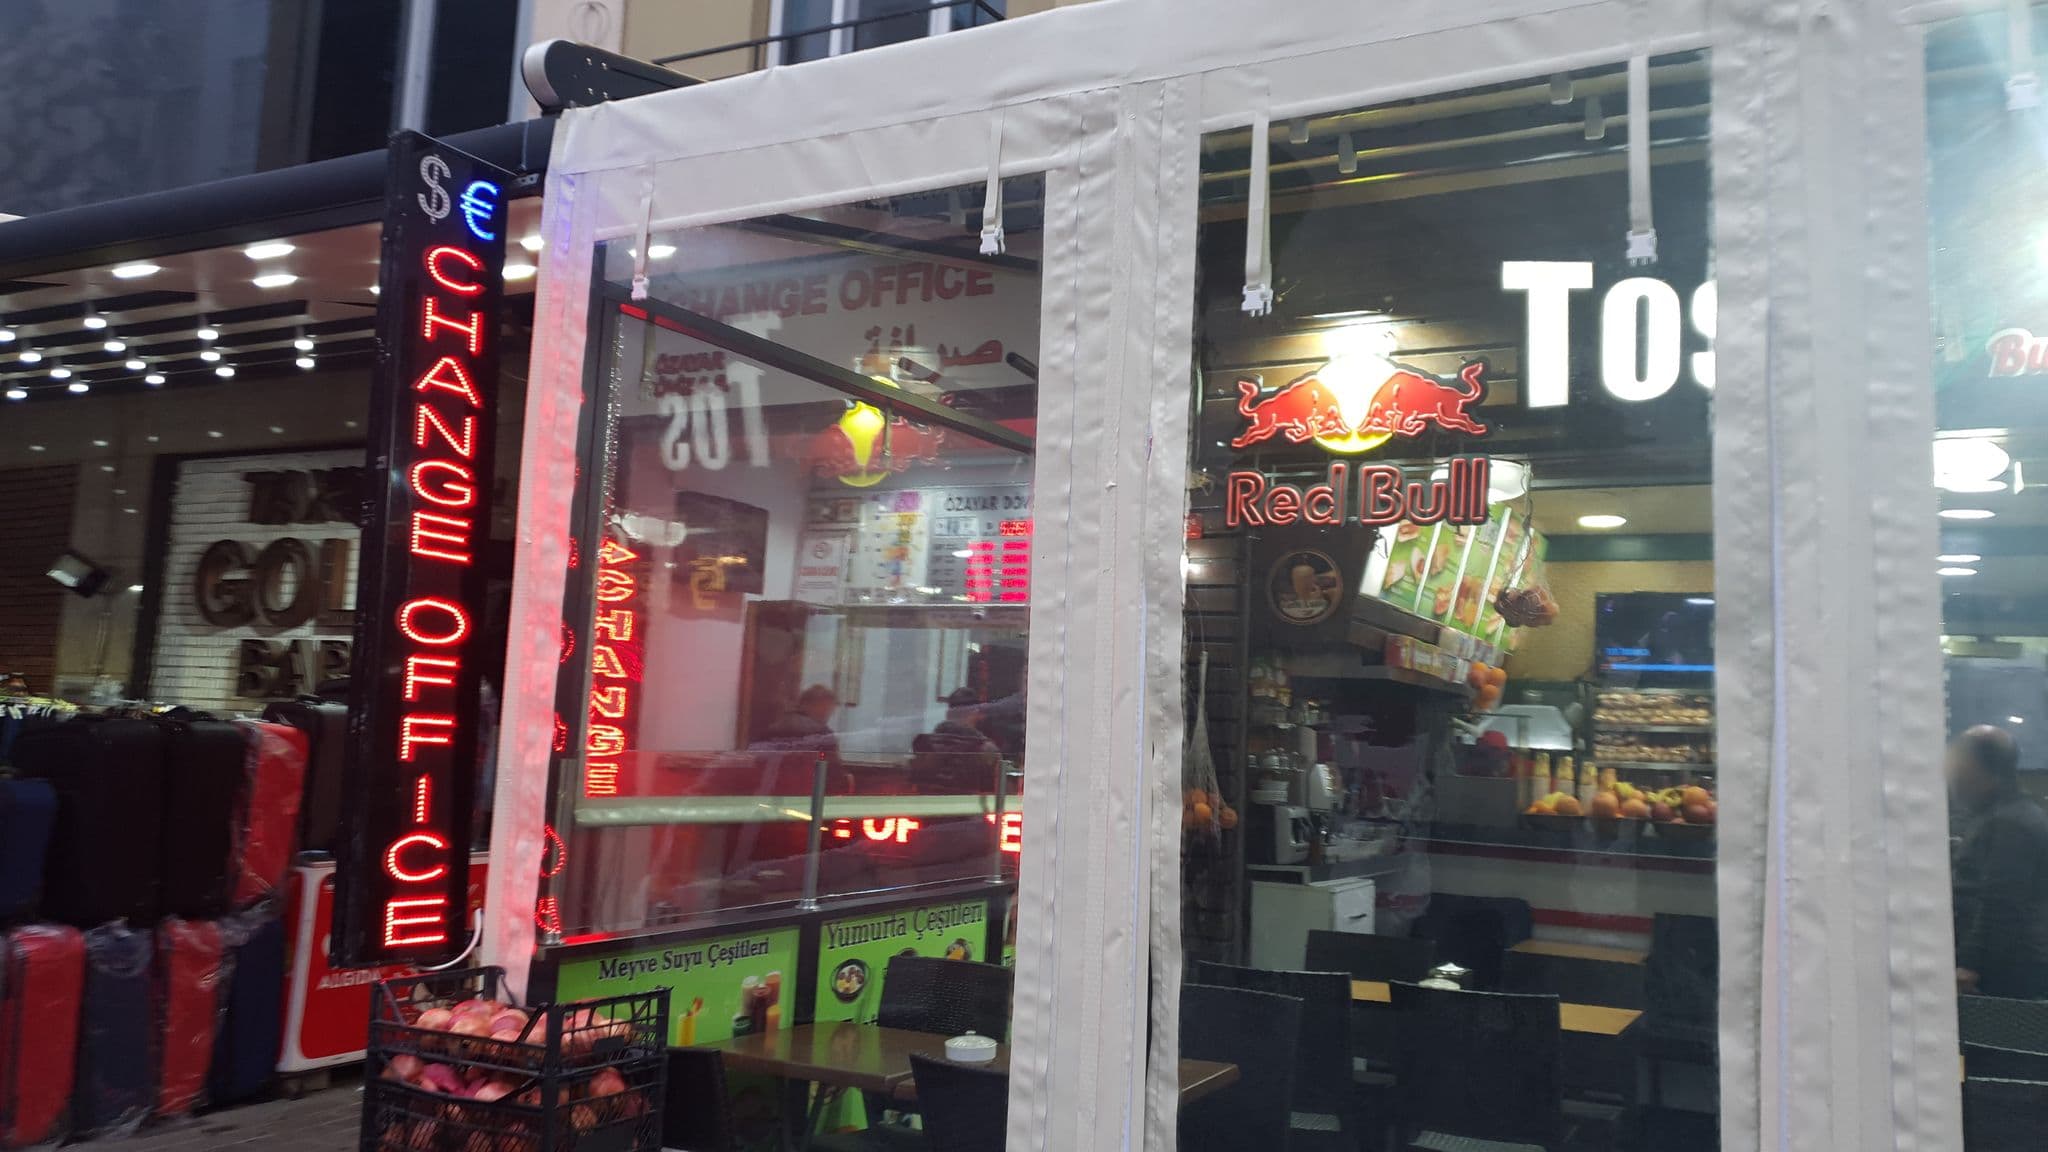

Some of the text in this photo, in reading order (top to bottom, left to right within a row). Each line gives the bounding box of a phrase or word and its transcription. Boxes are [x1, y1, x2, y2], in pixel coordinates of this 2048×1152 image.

[838, 262, 995, 312] OFFICE
[410, 246, 483, 562] CHANGE
[1226, 456, 1489, 528] Red Bull
[384, 599, 467, 948] OFFICE
[826, 903, 984, 950] Yumurta Çeşitleri
[598, 937, 769, 981] Meyve Suyu Çeşitleri
